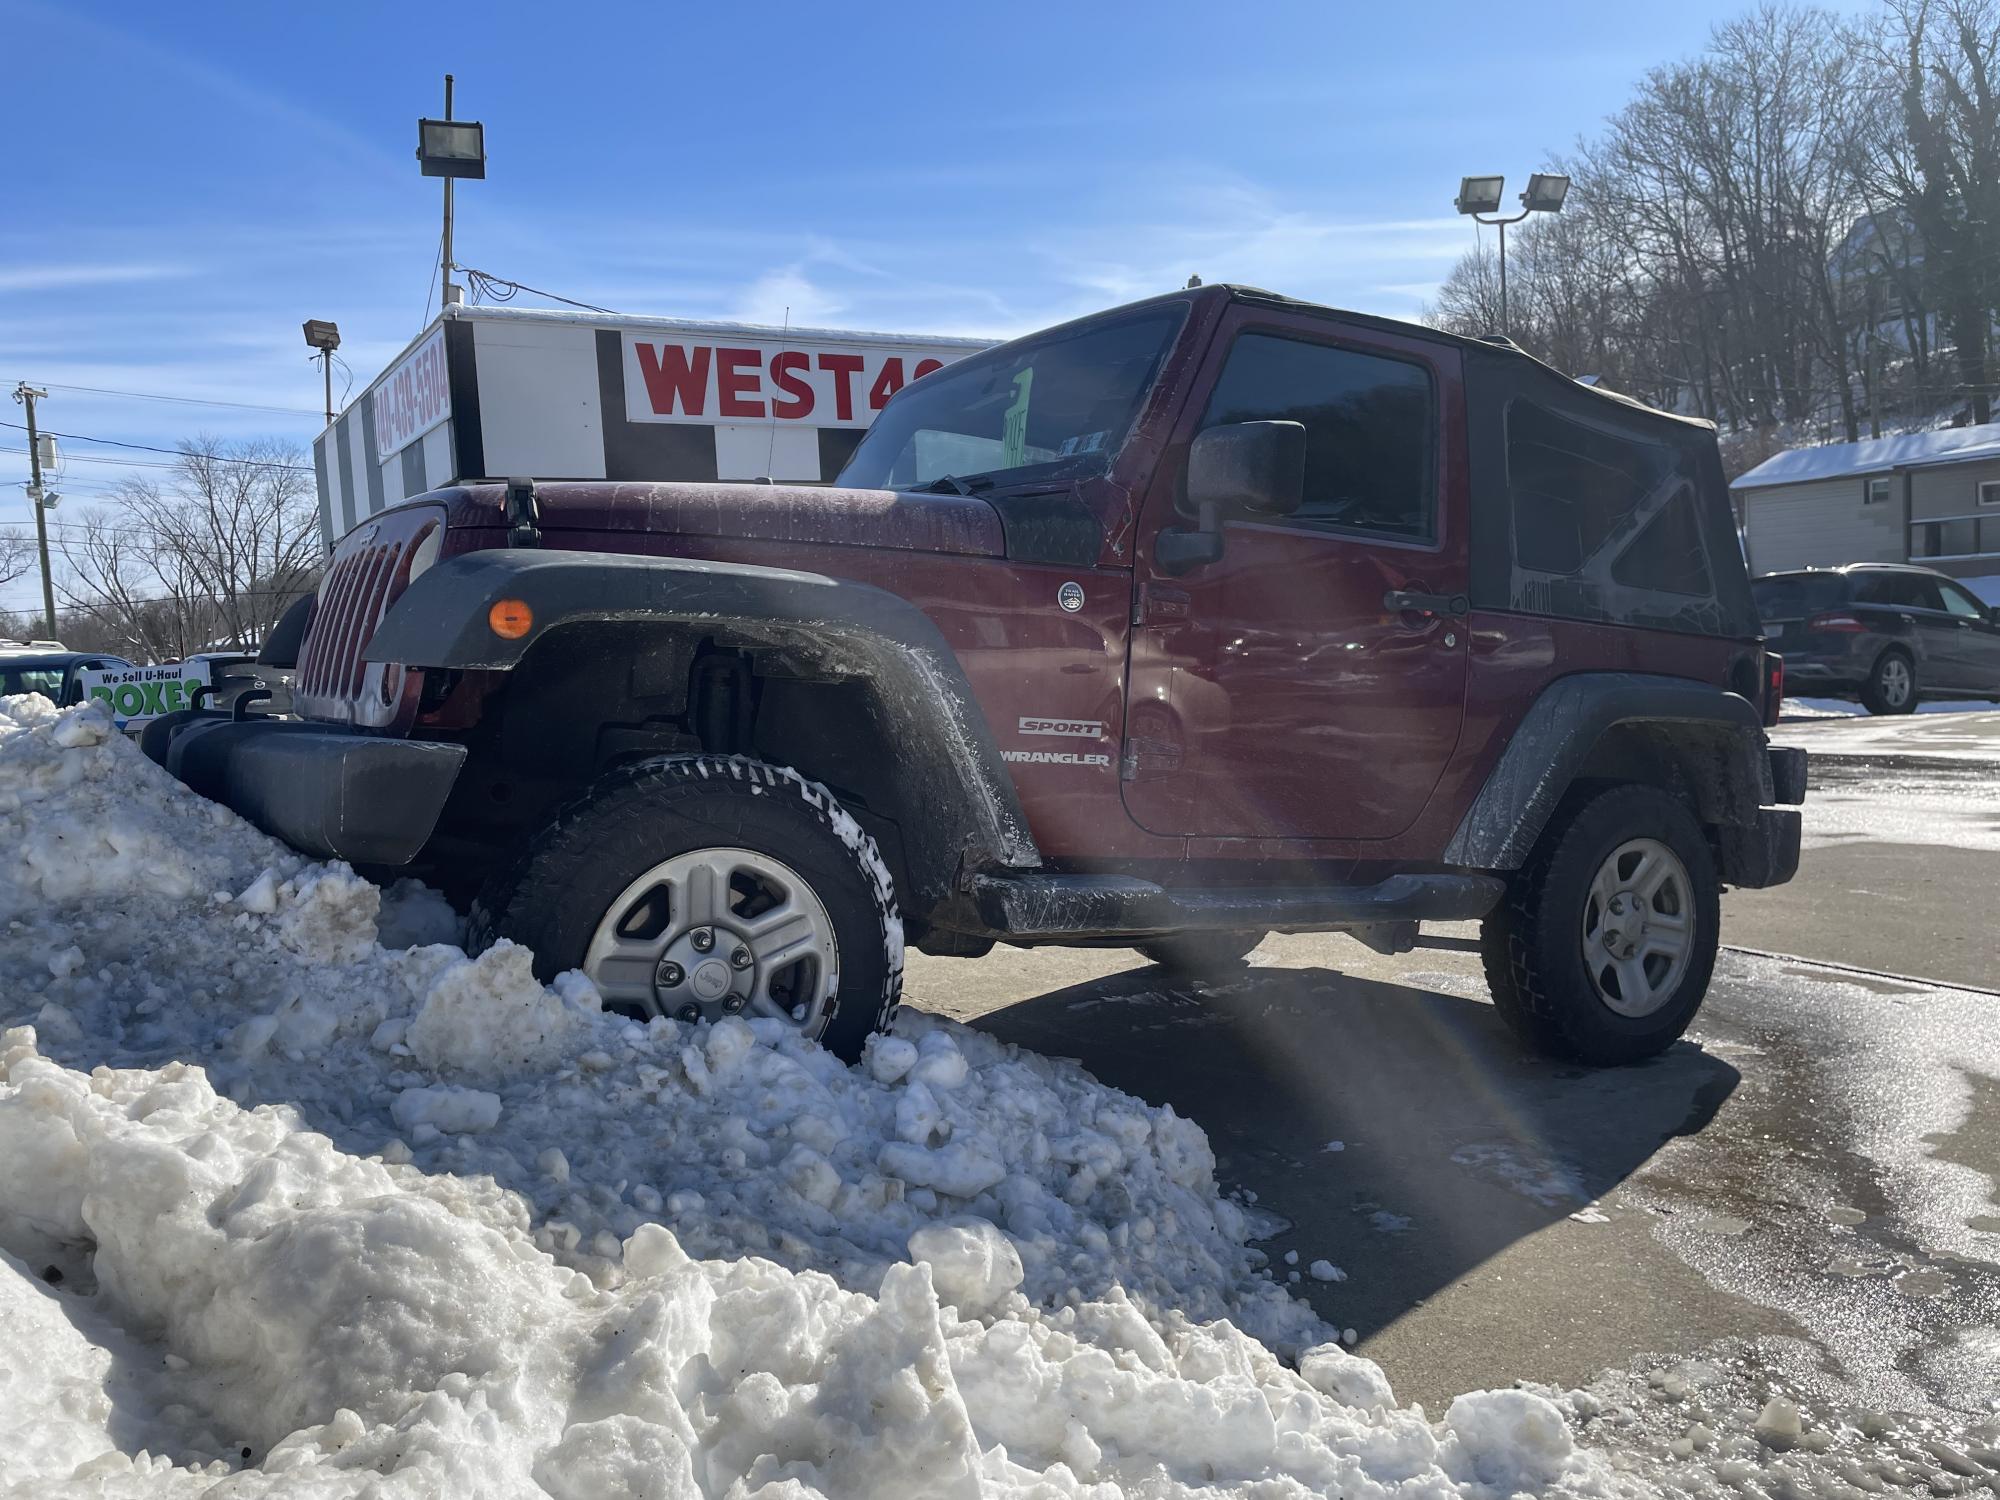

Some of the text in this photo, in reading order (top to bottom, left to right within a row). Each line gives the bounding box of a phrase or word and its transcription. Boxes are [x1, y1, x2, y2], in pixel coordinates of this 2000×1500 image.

[635, 342, 944, 421] WEST4
[374, 336, 449, 452] 740-439-5504
[102, 668, 182, 684] We Sell U-Haul
[1020, 720, 1102, 735] SPORT
[1000, 750, 1110, 767] WRANGLER
